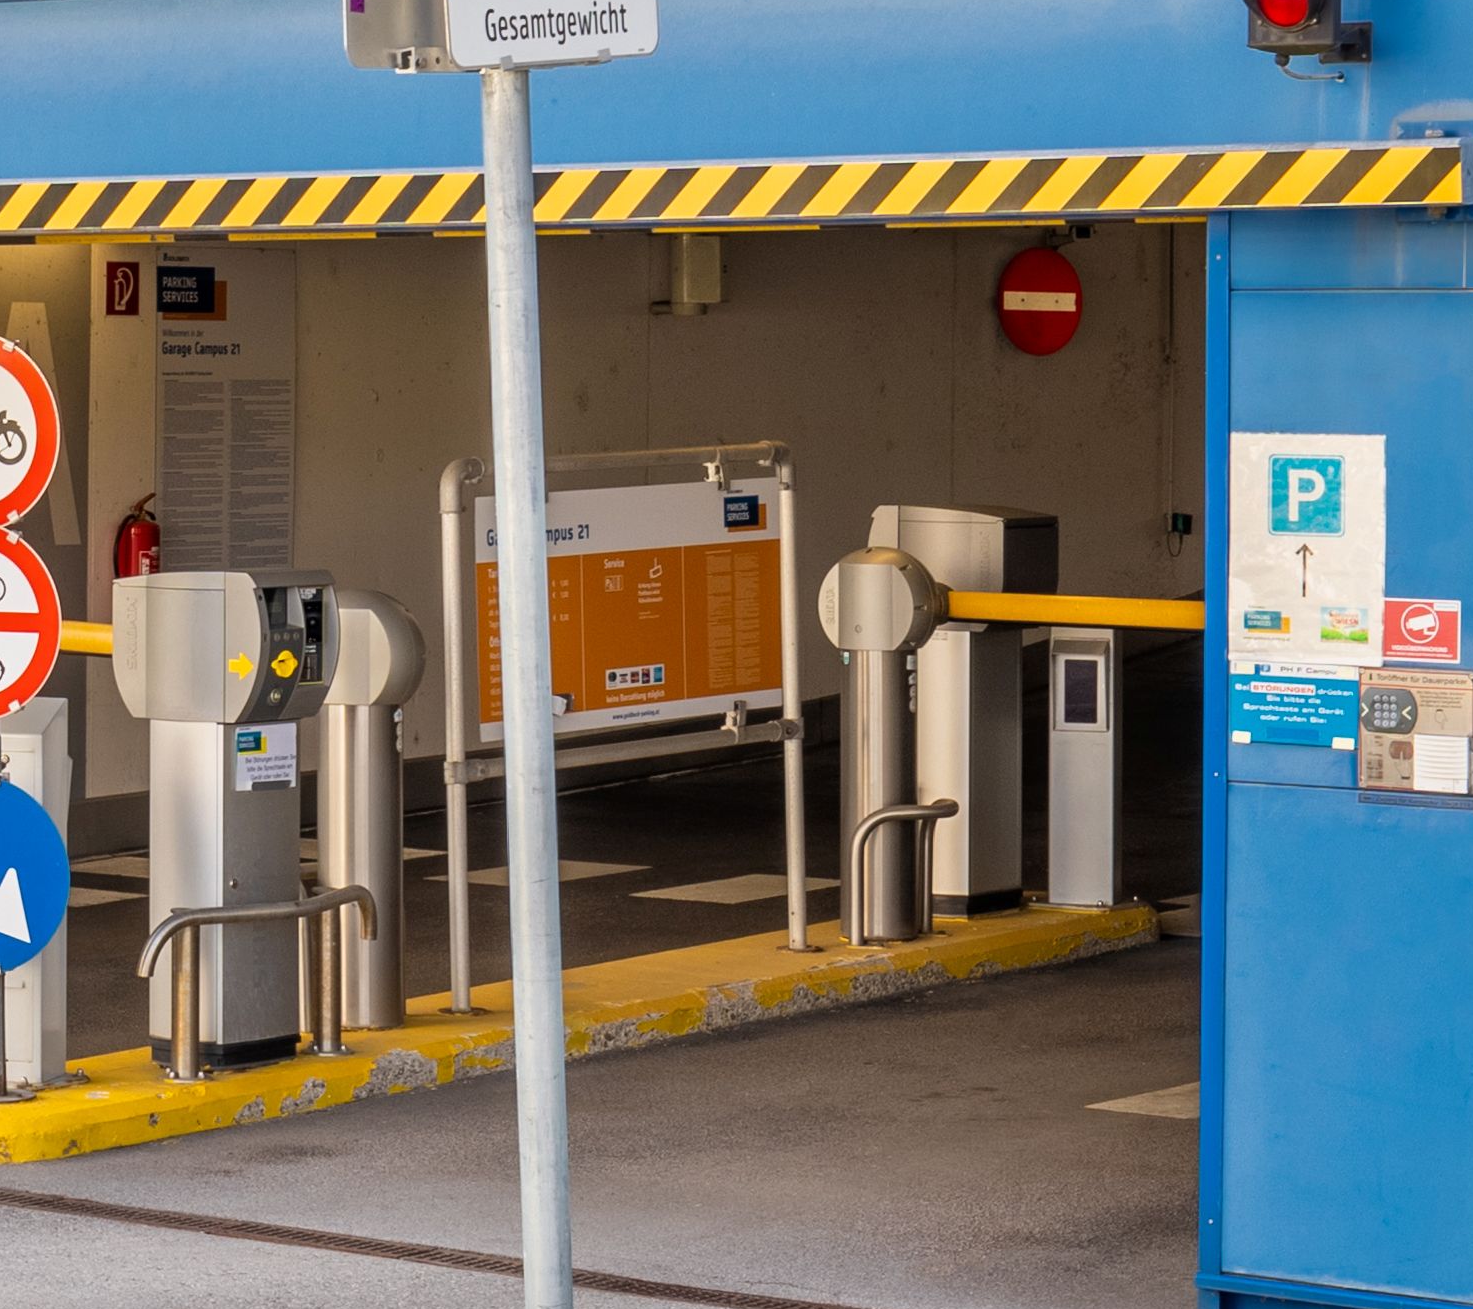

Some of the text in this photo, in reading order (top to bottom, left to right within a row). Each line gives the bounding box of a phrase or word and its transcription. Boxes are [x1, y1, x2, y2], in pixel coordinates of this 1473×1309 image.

[484, 1, 629, 45] Gesamtgewicht
[162, 276, 197, 289] PARKING
[162, 291, 199, 303] SERVICES
[162, 342, 241, 358] Garage Campus 21
[1287, 468, 1326, 522] P
[545, 524, 590, 545] mpus 21
[1376, 673, 1468, 685] Toröffner für Dauerparker
[1252, 684, 1315, 694] STÖRUNGEN
[1316, 688, 1354, 697] drücken
[1266, 695, 1281, 703] Sie
[1283, 696, 1305, 704] bitte
[1242, 702, 1300, 713] Sprechtaste
[1318, 706, 1345, 716] Gerät
[1283, 715, 1308, 723] rufen
